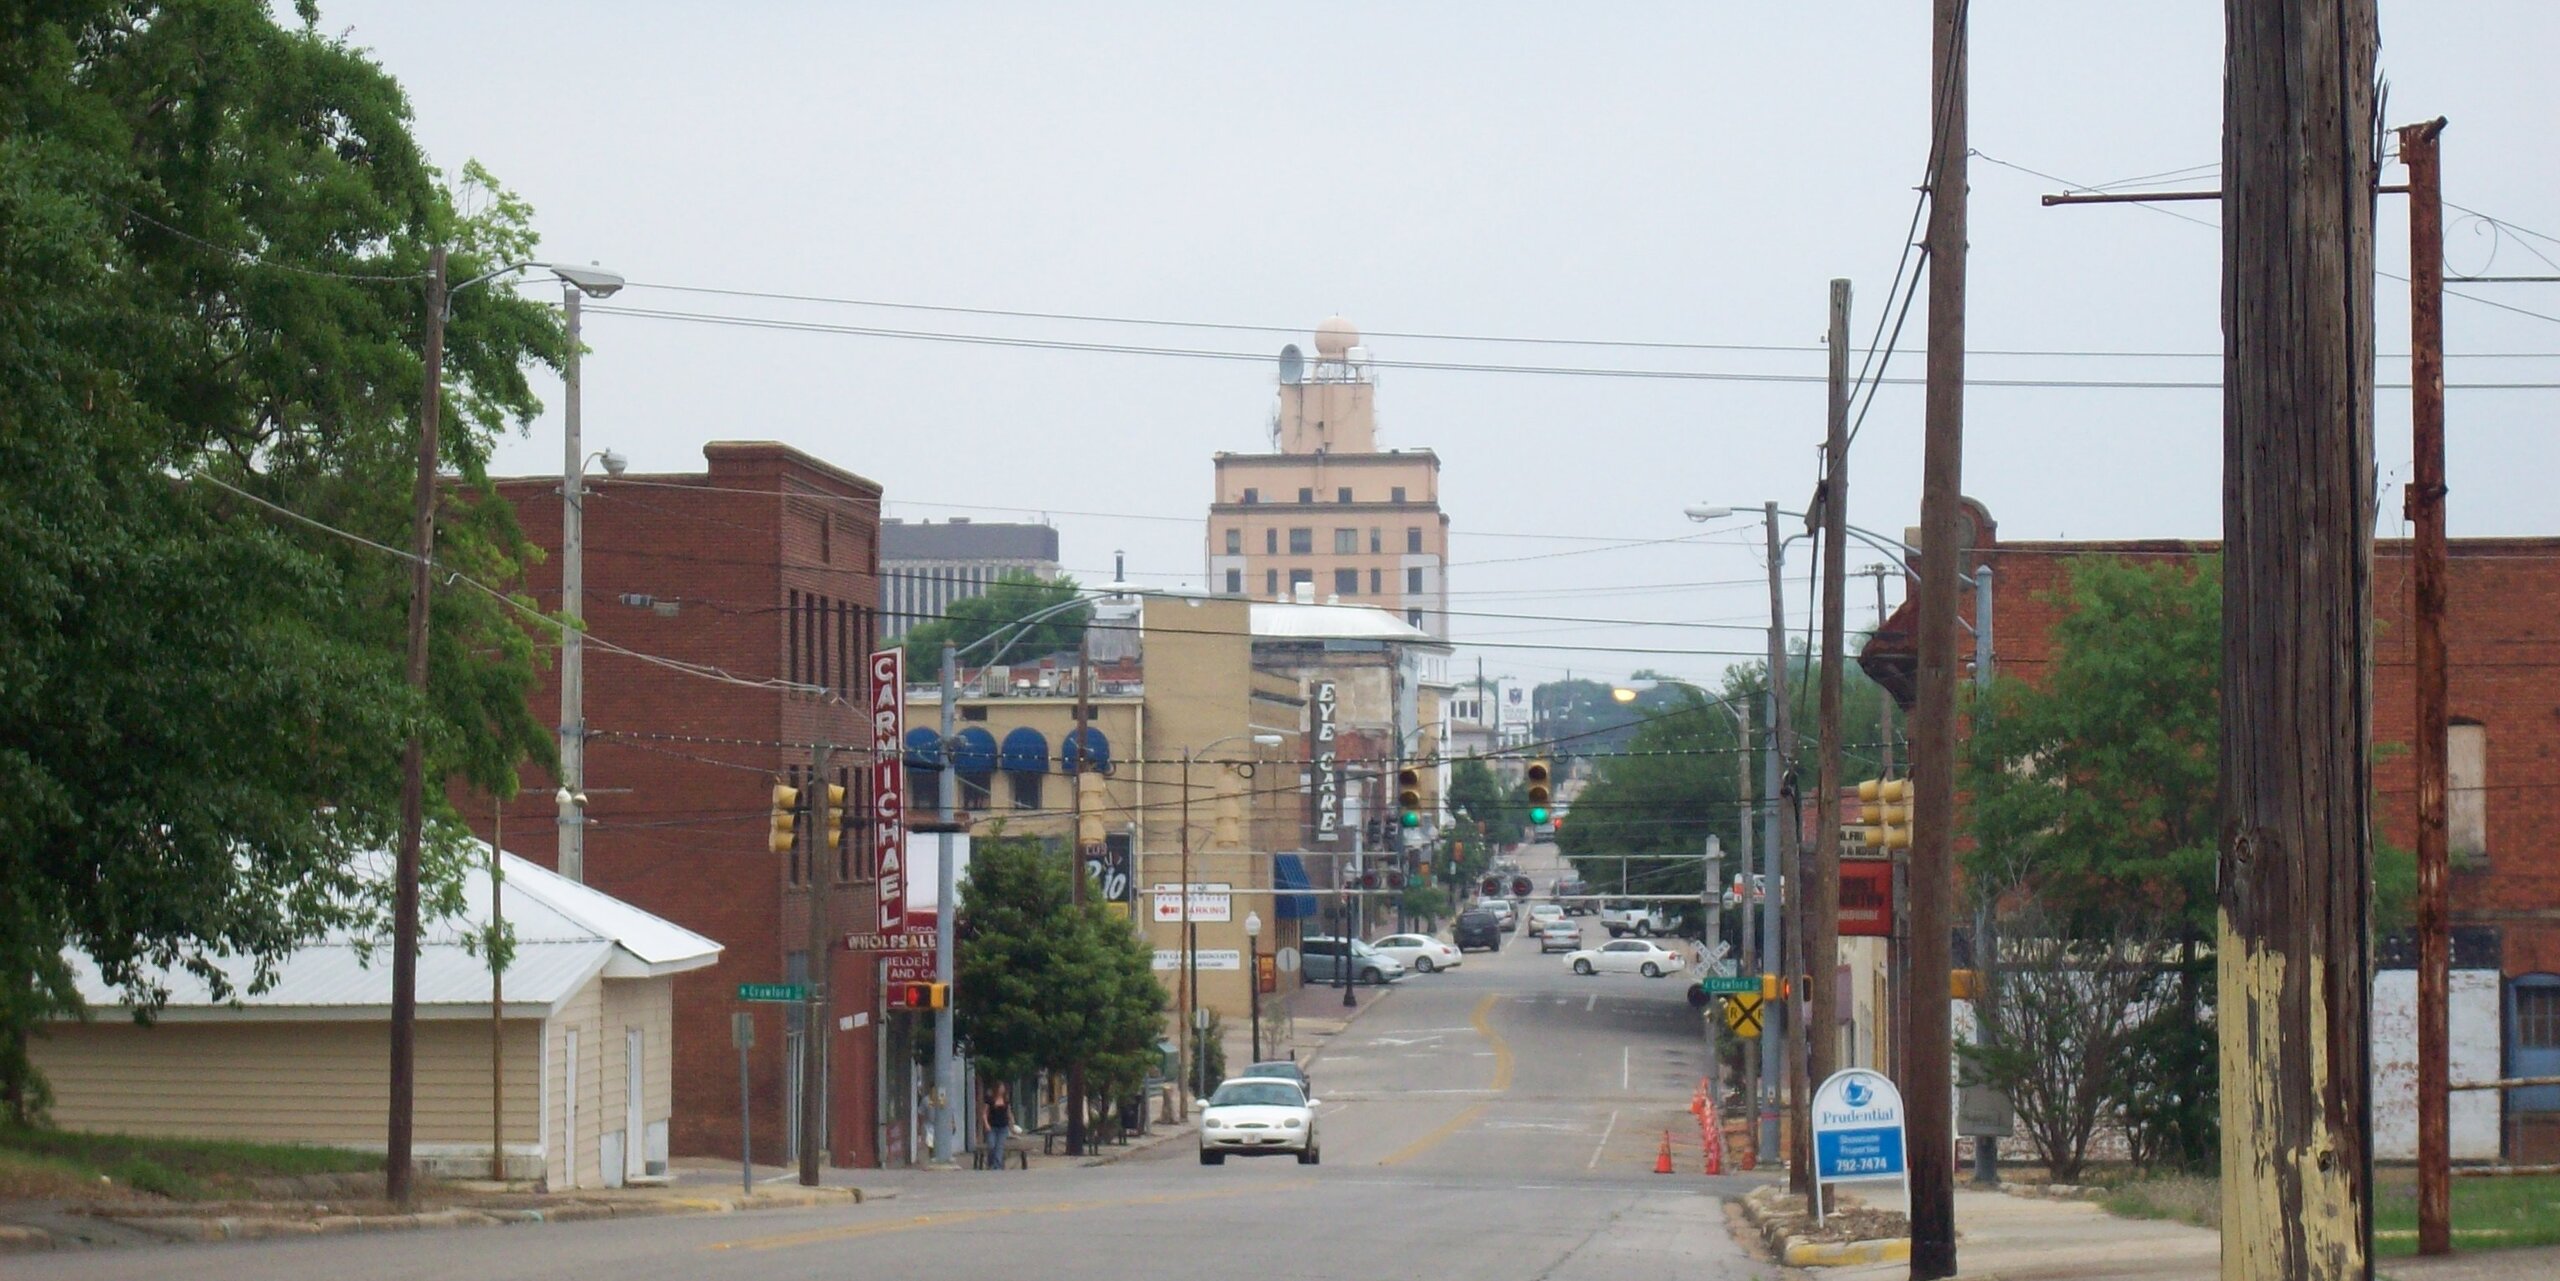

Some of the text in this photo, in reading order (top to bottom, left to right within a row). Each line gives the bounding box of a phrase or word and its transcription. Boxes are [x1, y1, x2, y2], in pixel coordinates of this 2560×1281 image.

[1318, 683, 1337, 832] EYE CARE
[874, 657, 901, 930] CARMICHAEL
[1188, 904, 1227, 914] ARKING
[847, 933, 937, 950] WHOLESALE
[890, 967, 916, 979] AND
[748, 984, 792, 998] Crawford
[1711, 979, 1751, 991] Crawford
[1729, 1006, 1739, 1019] R
[1822, 1108, 1894, 1125] Prudential
[1835, 1157, 1888, 1172] 792-7474
